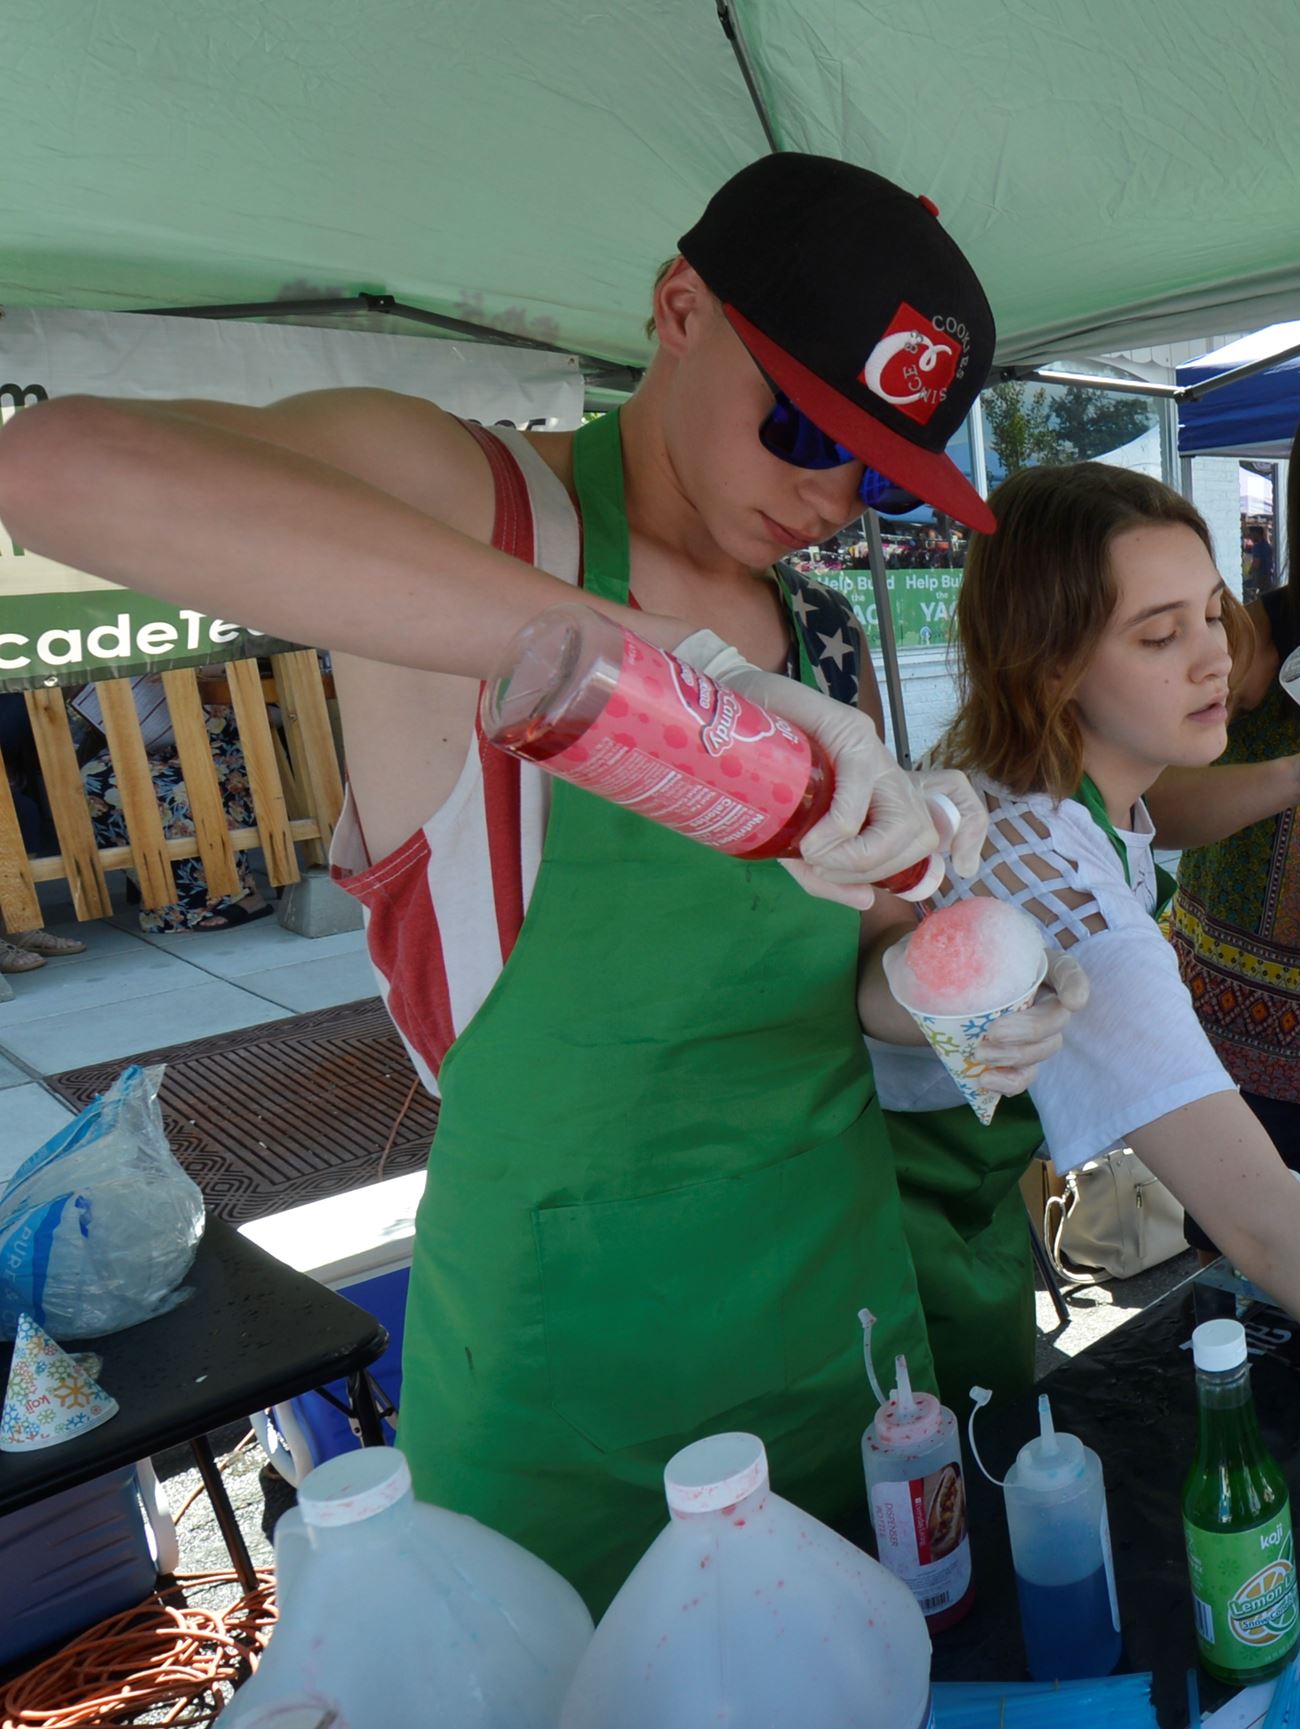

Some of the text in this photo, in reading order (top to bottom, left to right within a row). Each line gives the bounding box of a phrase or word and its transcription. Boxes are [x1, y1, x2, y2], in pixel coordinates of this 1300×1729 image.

[906, 575, 938, 591] Help
[708, 695, 739, 749] Candy
[1260, 1524, 1284, 1550] koji
[1231, 1584, 1282, 1615] Lemon
